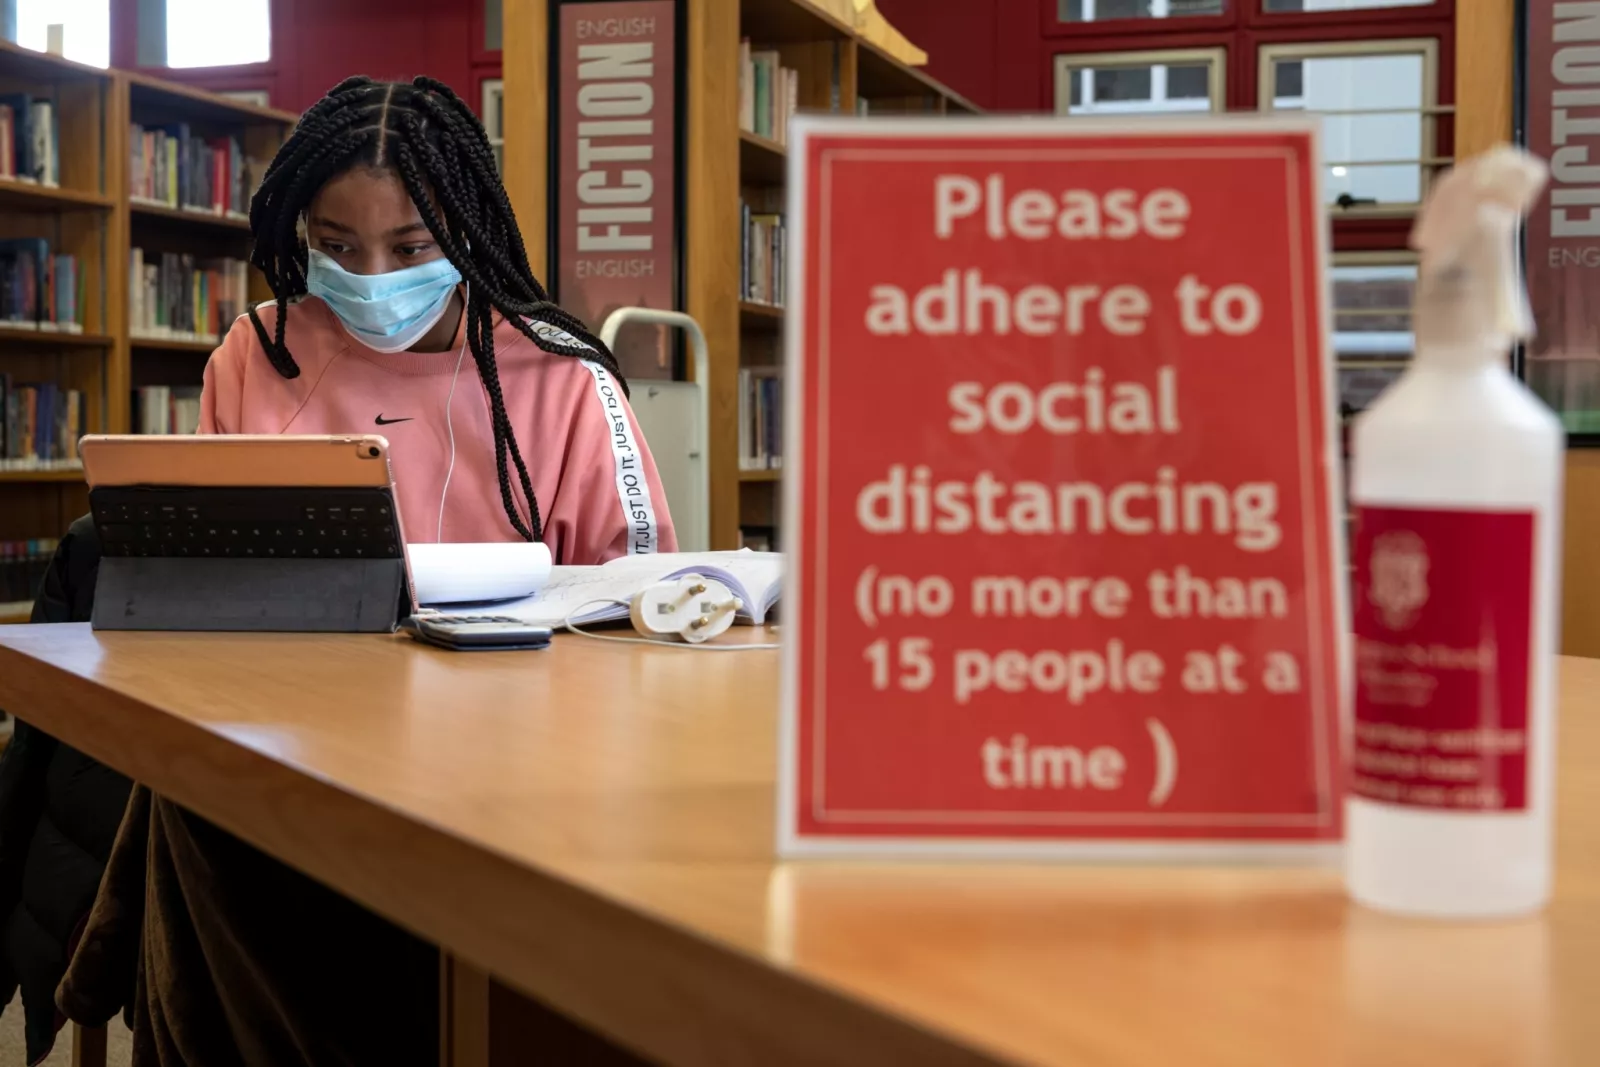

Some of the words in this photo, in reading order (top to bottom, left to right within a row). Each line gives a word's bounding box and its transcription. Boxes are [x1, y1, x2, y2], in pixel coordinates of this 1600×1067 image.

[576, 17, 655, 38] ENGLISH
[577, 42, 653, 252] FICTION
[1550, 1, 1600, 238] FICTION
[935, 174, 1190, 239] Please
[576, 259, 655, 279] ENGLISH
[865, 269, 1150, 335] adhere
[1176, 276, 1261, 335] to
[601, 385, 617, 408] DO
[948, 366, 1179, 434] social
[610, 412, 632, 452] JUST
[623, 474, 642, 496] DO
[857, 464, 1281, 551] distancing
[629, 500, 650, 539] JUST
[856, 568, 953, 625] (no
[972, 577, 1130, 617] more
[1149, 567, 1287, 618] than
[865, 638, 934, 691] 15
[954, 640, 1163, 703] people
[1183, 646, 1244, 692] at
[1264, 652, 1299, 691] a
[982, 735, 1125, 789] time
